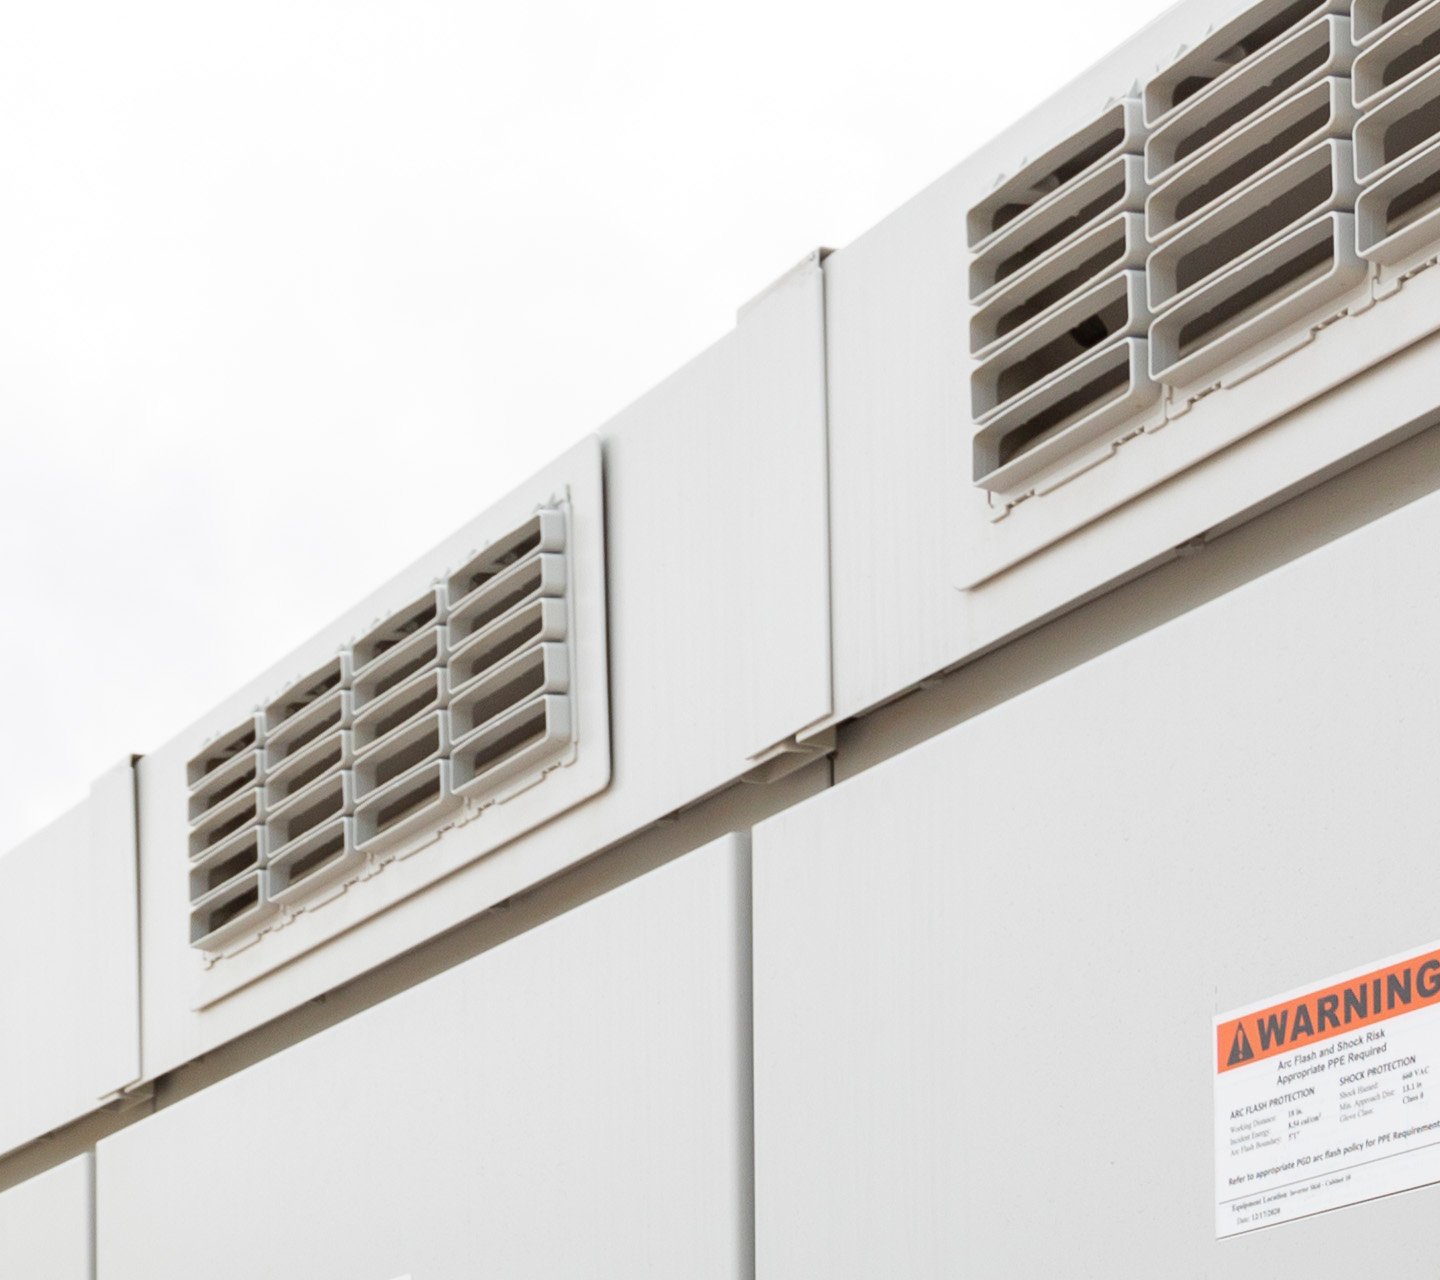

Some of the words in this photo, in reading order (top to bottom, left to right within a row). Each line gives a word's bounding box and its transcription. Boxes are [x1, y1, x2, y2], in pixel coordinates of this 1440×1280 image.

[1277, 1060, 1292, 1071] Arc
[1294, 1051, 1317, 1066] Flash
[1319, 1044, 1335, 1058] and
[1337, 1036, 1363, 1052] Shock
[1366, 1028, 1386, 1043] Risk
[1277, 1063, 1326, 1086] Appropriate
[1327, 1055, 1345, 1070] PPE
[1347, 1043, 1388, 1063] Required
[1339, 1071, 1365, 1087] SHOCK
[1367, 1055, 1417, 1077] PROTECTION
[1230, 1107, 1244, 1120] ARC
[1245, 1100, 1267, 1115] FLASH
[1269, 1086, 1316, 1107] PROTECTION
[1228, 1175, 1246, 1186] Refer
[1247, 1172, 1254, 1181] to
[1255, 1162, 1295, 1179] appropriate
[1343, 1142, 1364, 1157] policy
[1365, 1138, 1376, 1148] for
[1377, 1132, 1391, 1145] PPE
